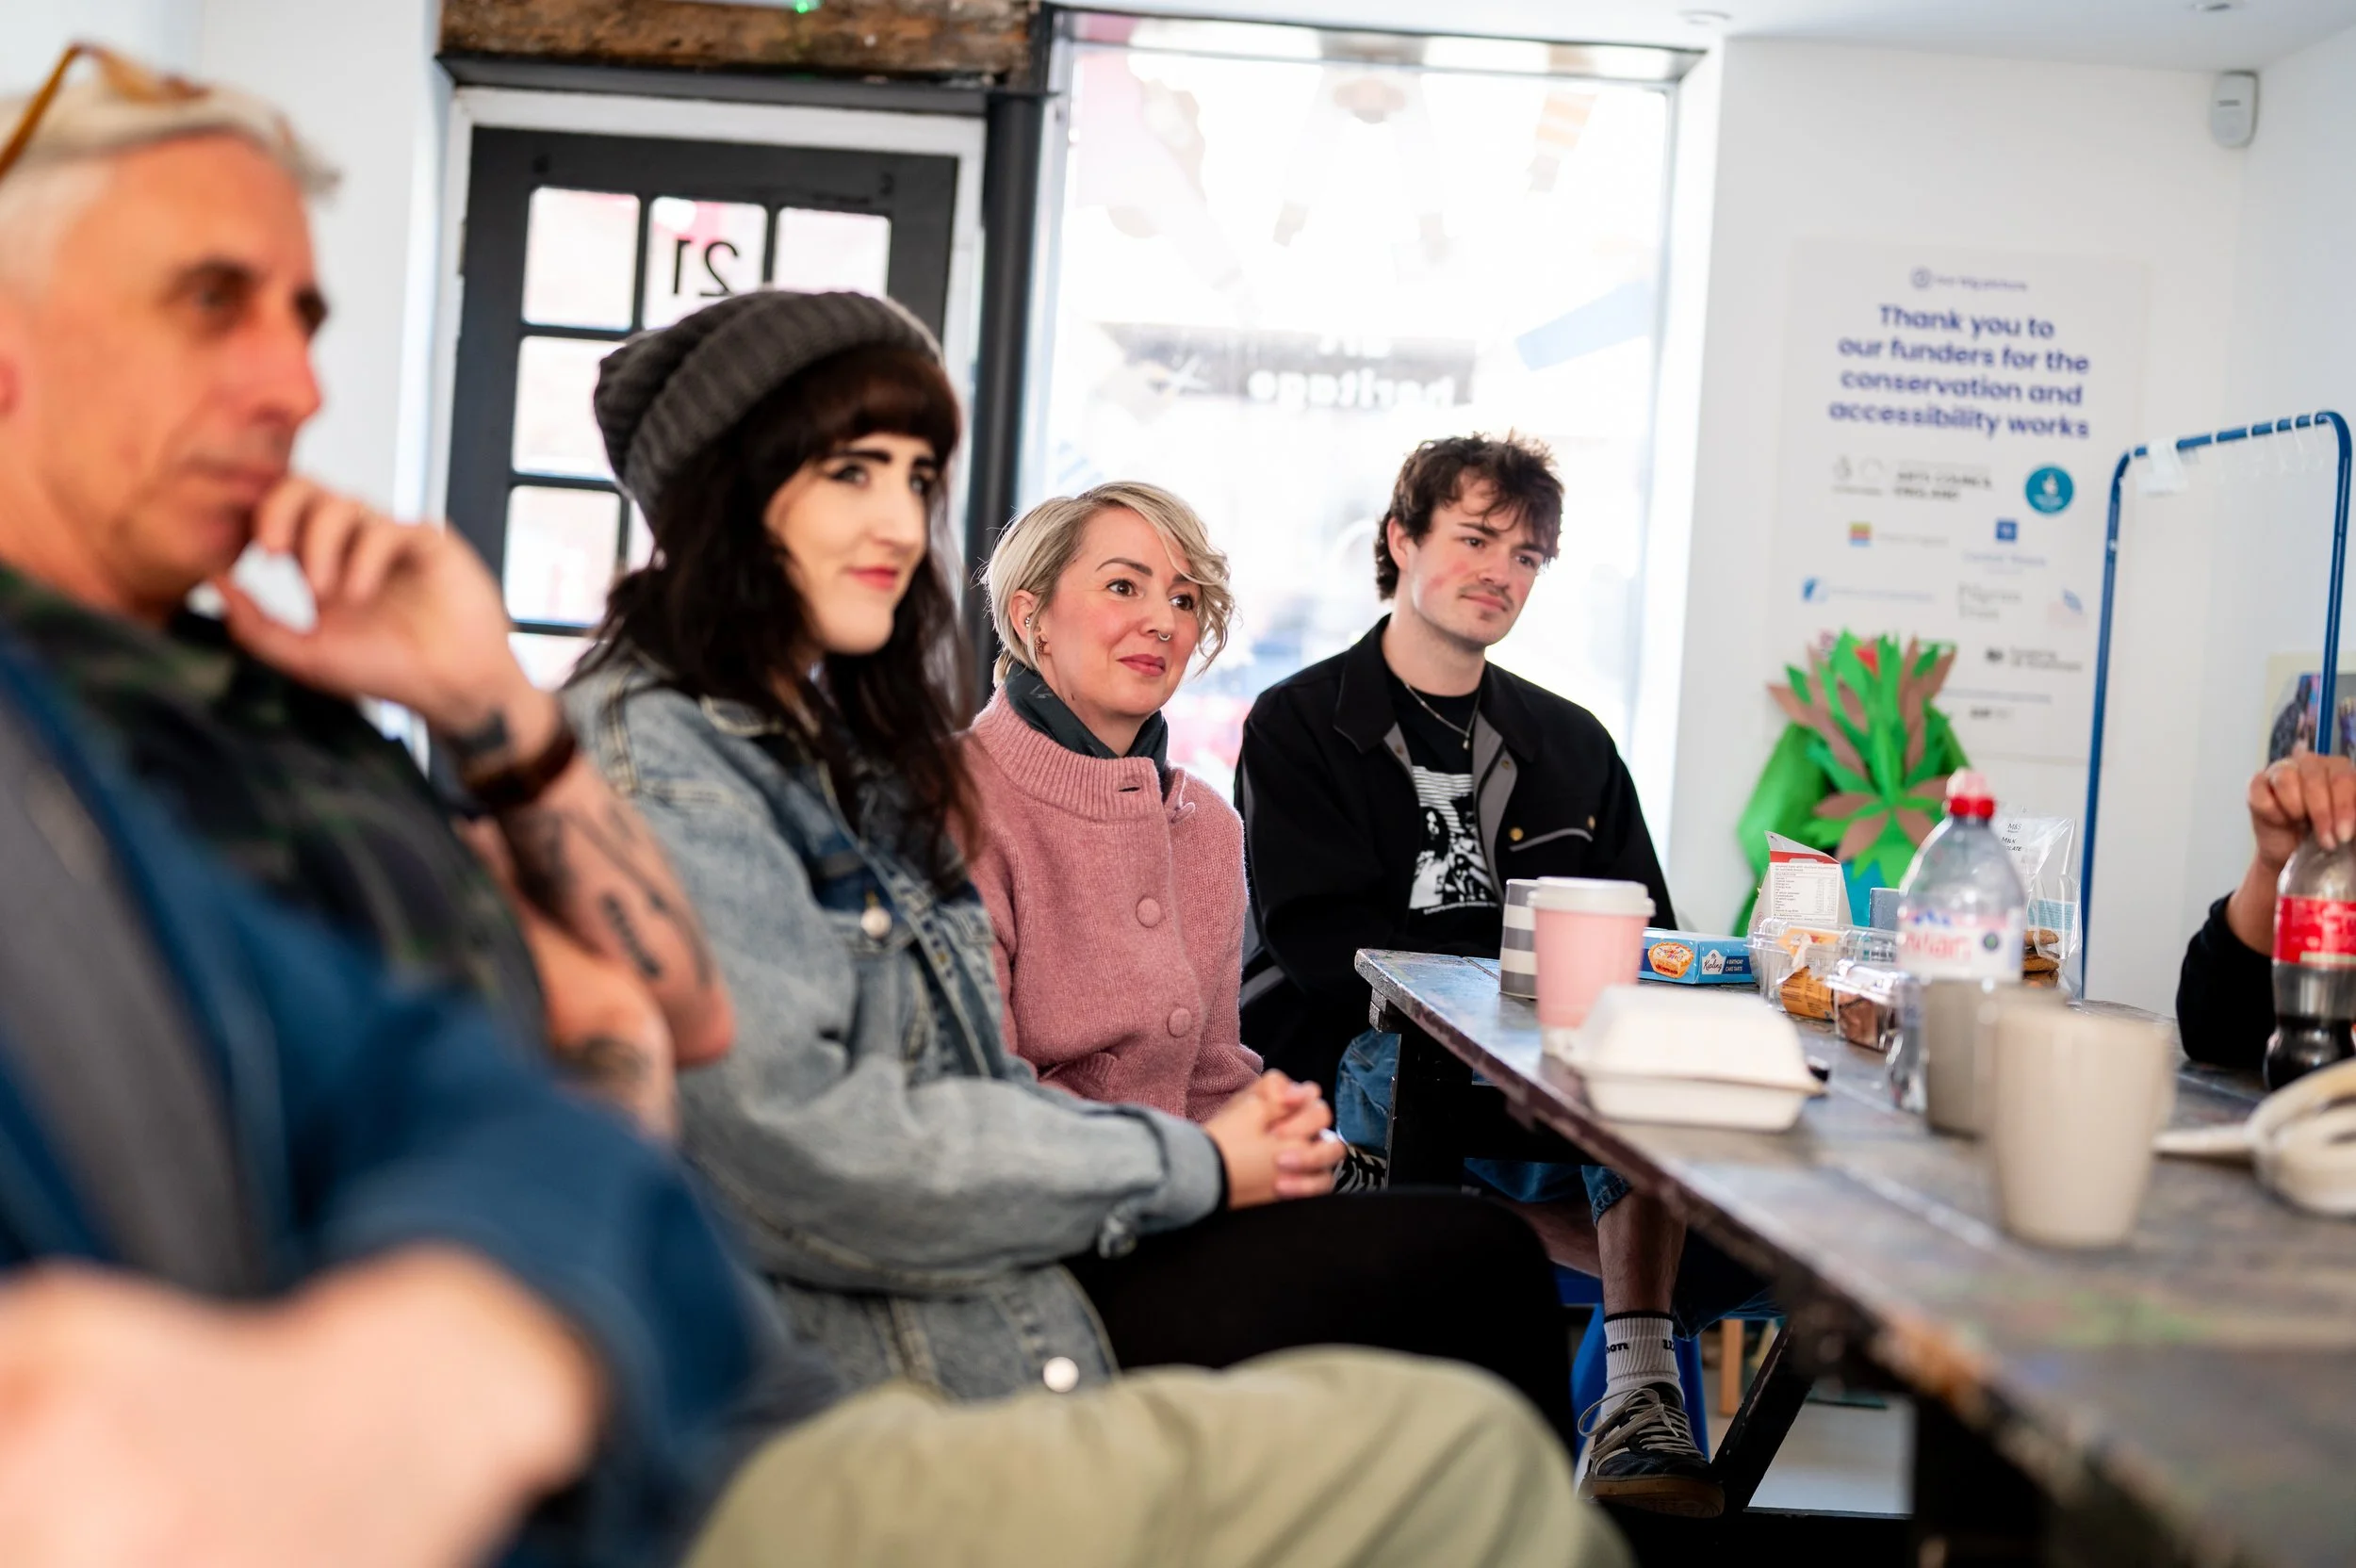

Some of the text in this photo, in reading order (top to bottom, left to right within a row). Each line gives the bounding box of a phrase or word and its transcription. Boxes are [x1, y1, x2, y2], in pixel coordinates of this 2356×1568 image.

[1879, 303, 2054, 339] Thank you to
[1838, 336, 2089, 373] our funders for the
[1840, 370, 2083, 406] conservation and
[1828, 401, 2089, 438] accessibility works
